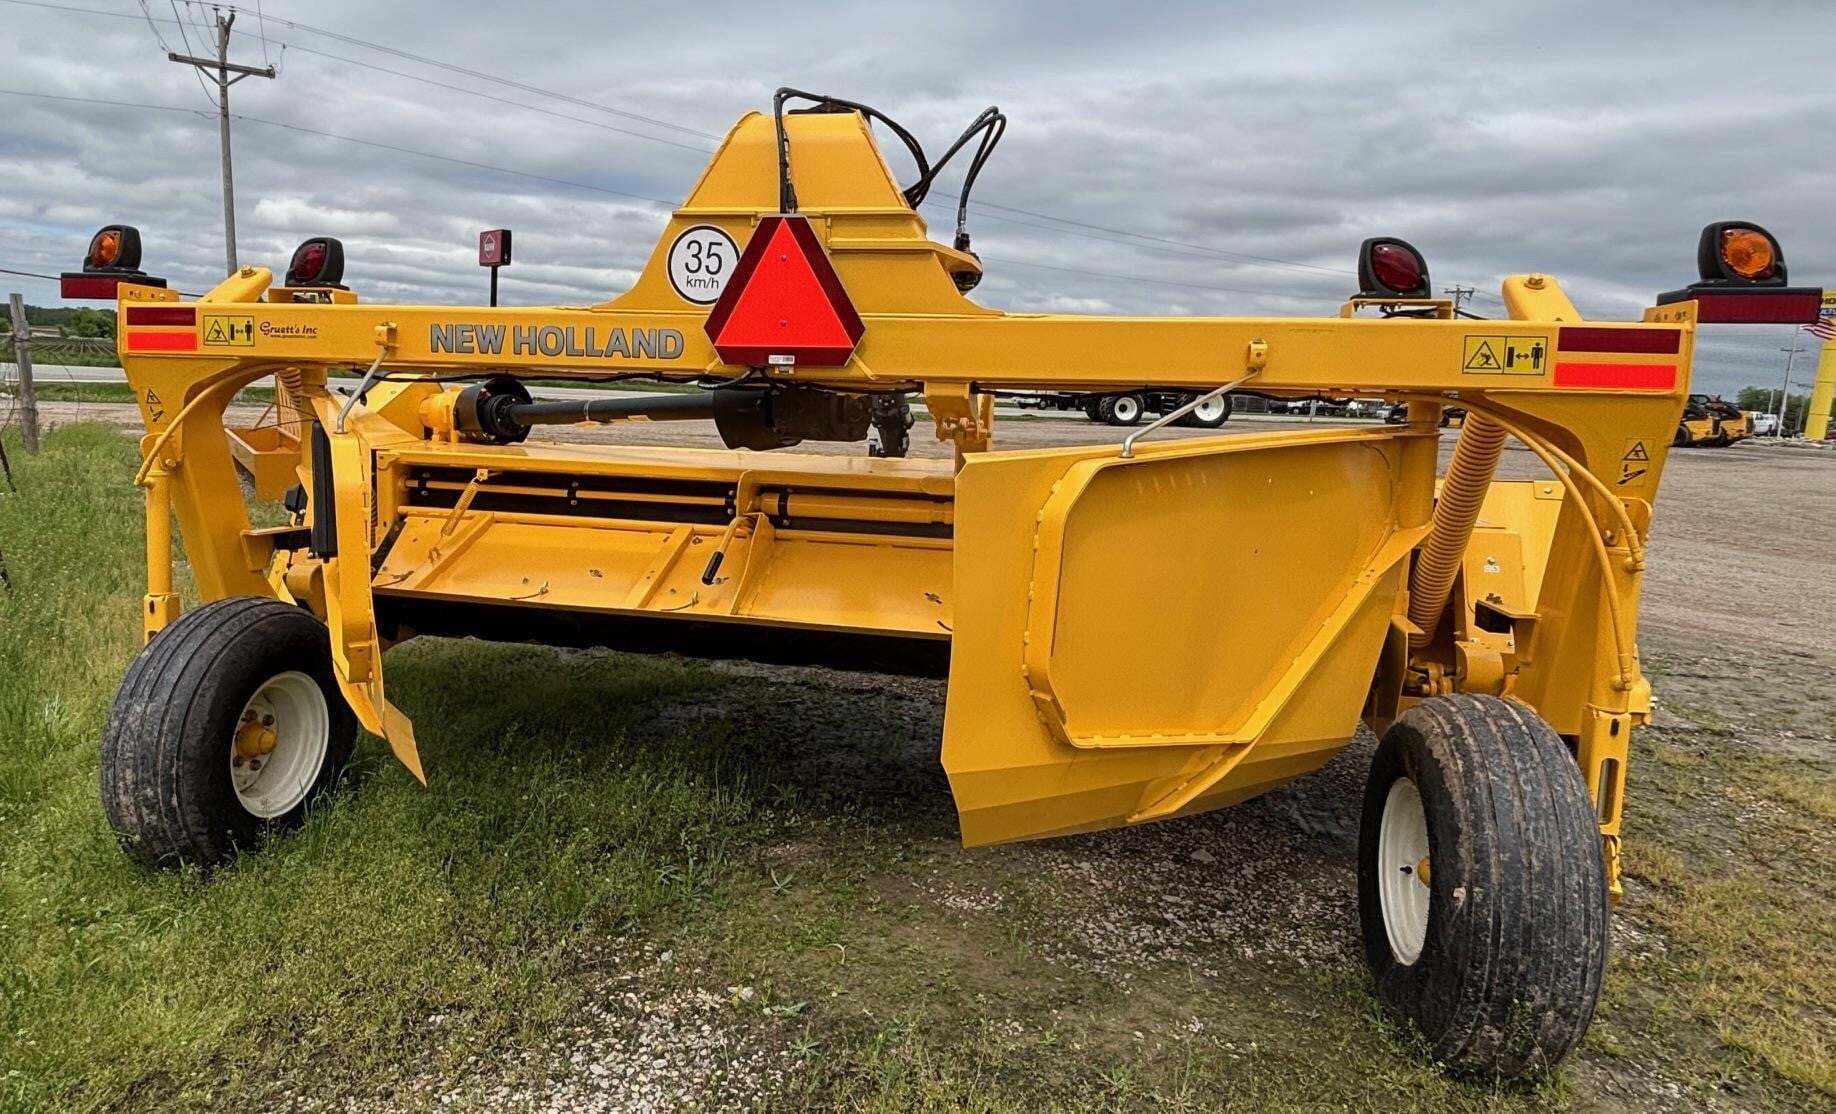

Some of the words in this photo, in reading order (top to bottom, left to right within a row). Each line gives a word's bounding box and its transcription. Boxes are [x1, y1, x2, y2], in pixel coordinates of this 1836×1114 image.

[684, 239, 723, 276] 35
[685, 275, 719, 290] km/h
[301, 324, 319, 335] Inc
[430, 323, 506, 355] NEW
[512, 325, 685, 360] HOLLAND
